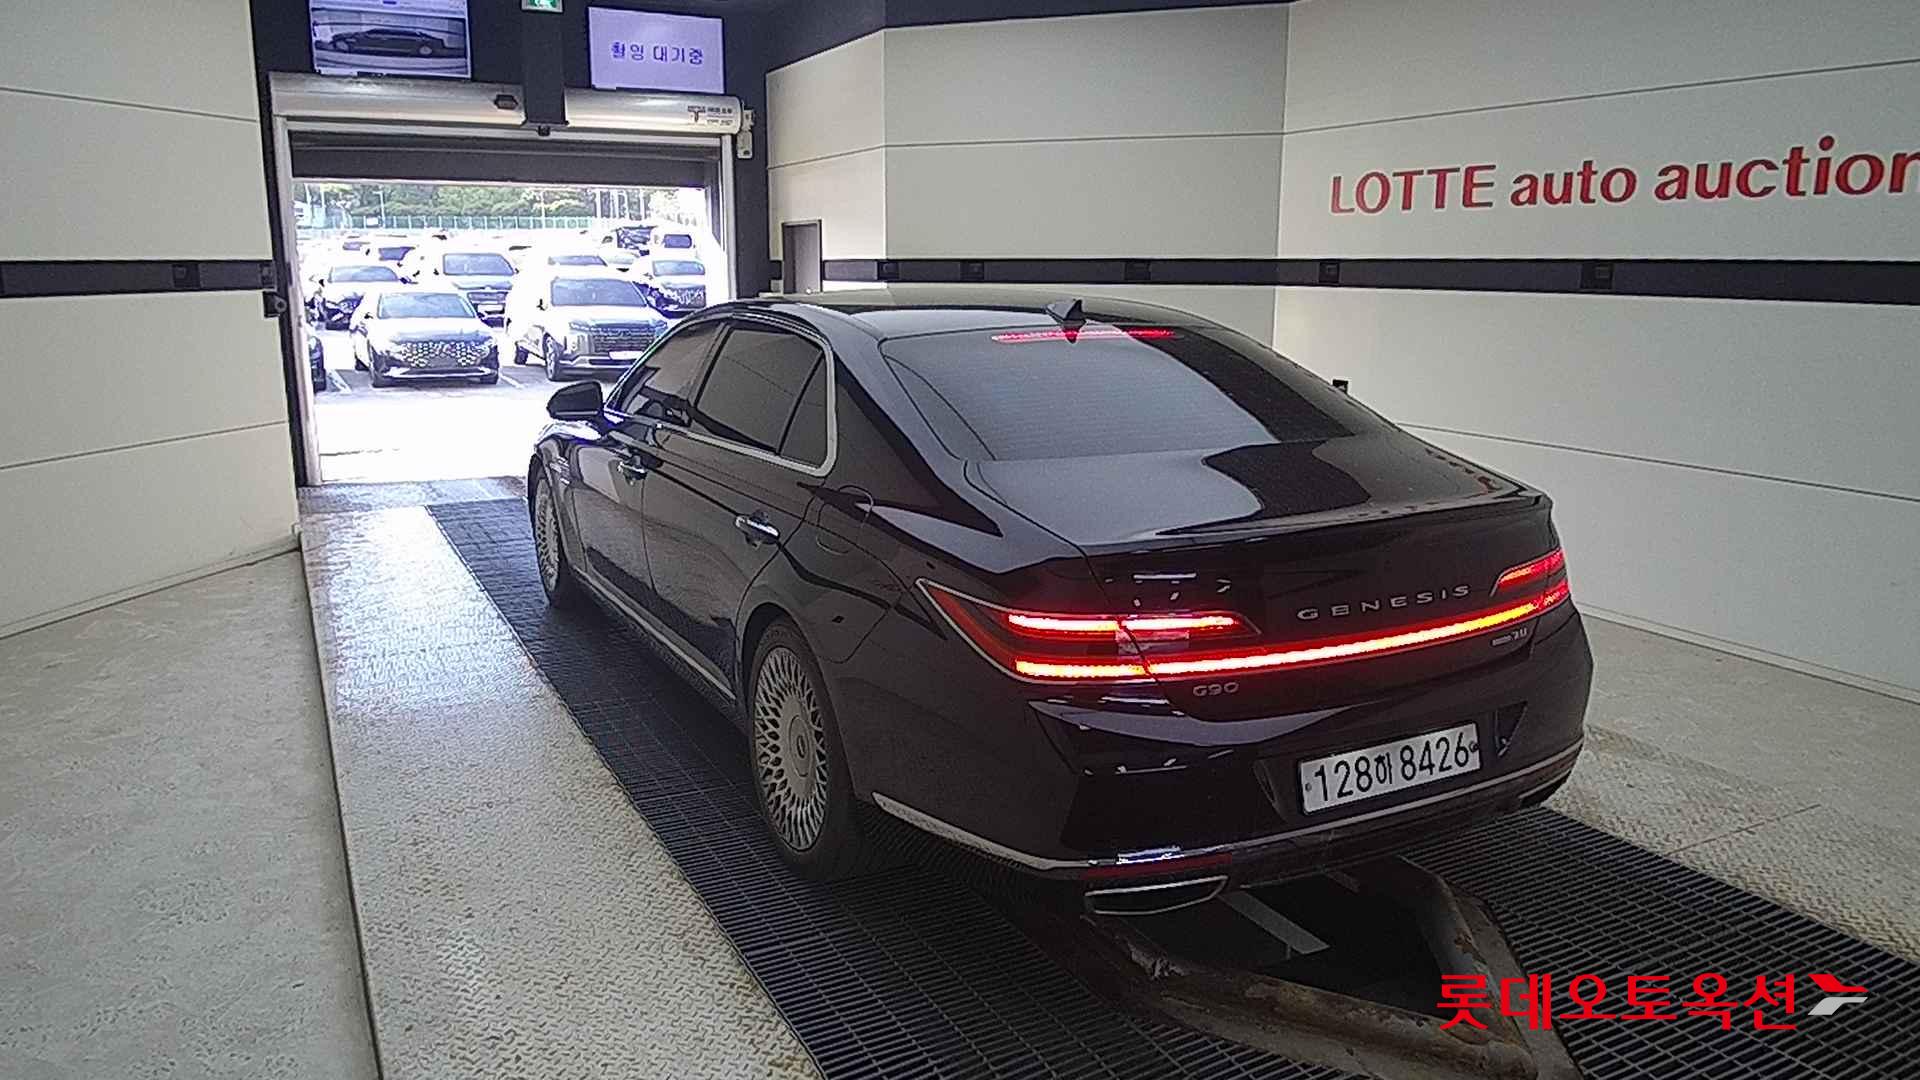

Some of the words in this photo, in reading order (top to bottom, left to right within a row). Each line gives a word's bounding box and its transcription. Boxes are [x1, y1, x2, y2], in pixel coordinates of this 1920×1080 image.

[653, 45, 703, 65] 대기중
[1330, 163, 1497, 214] LOTTE
[1510, 160, 1637, 206] auto
[1296, 585, 1470, 620] GENESIS
[1192, 682, 1240, 697] G90
[1400, 731, 1470, 781] 8426
